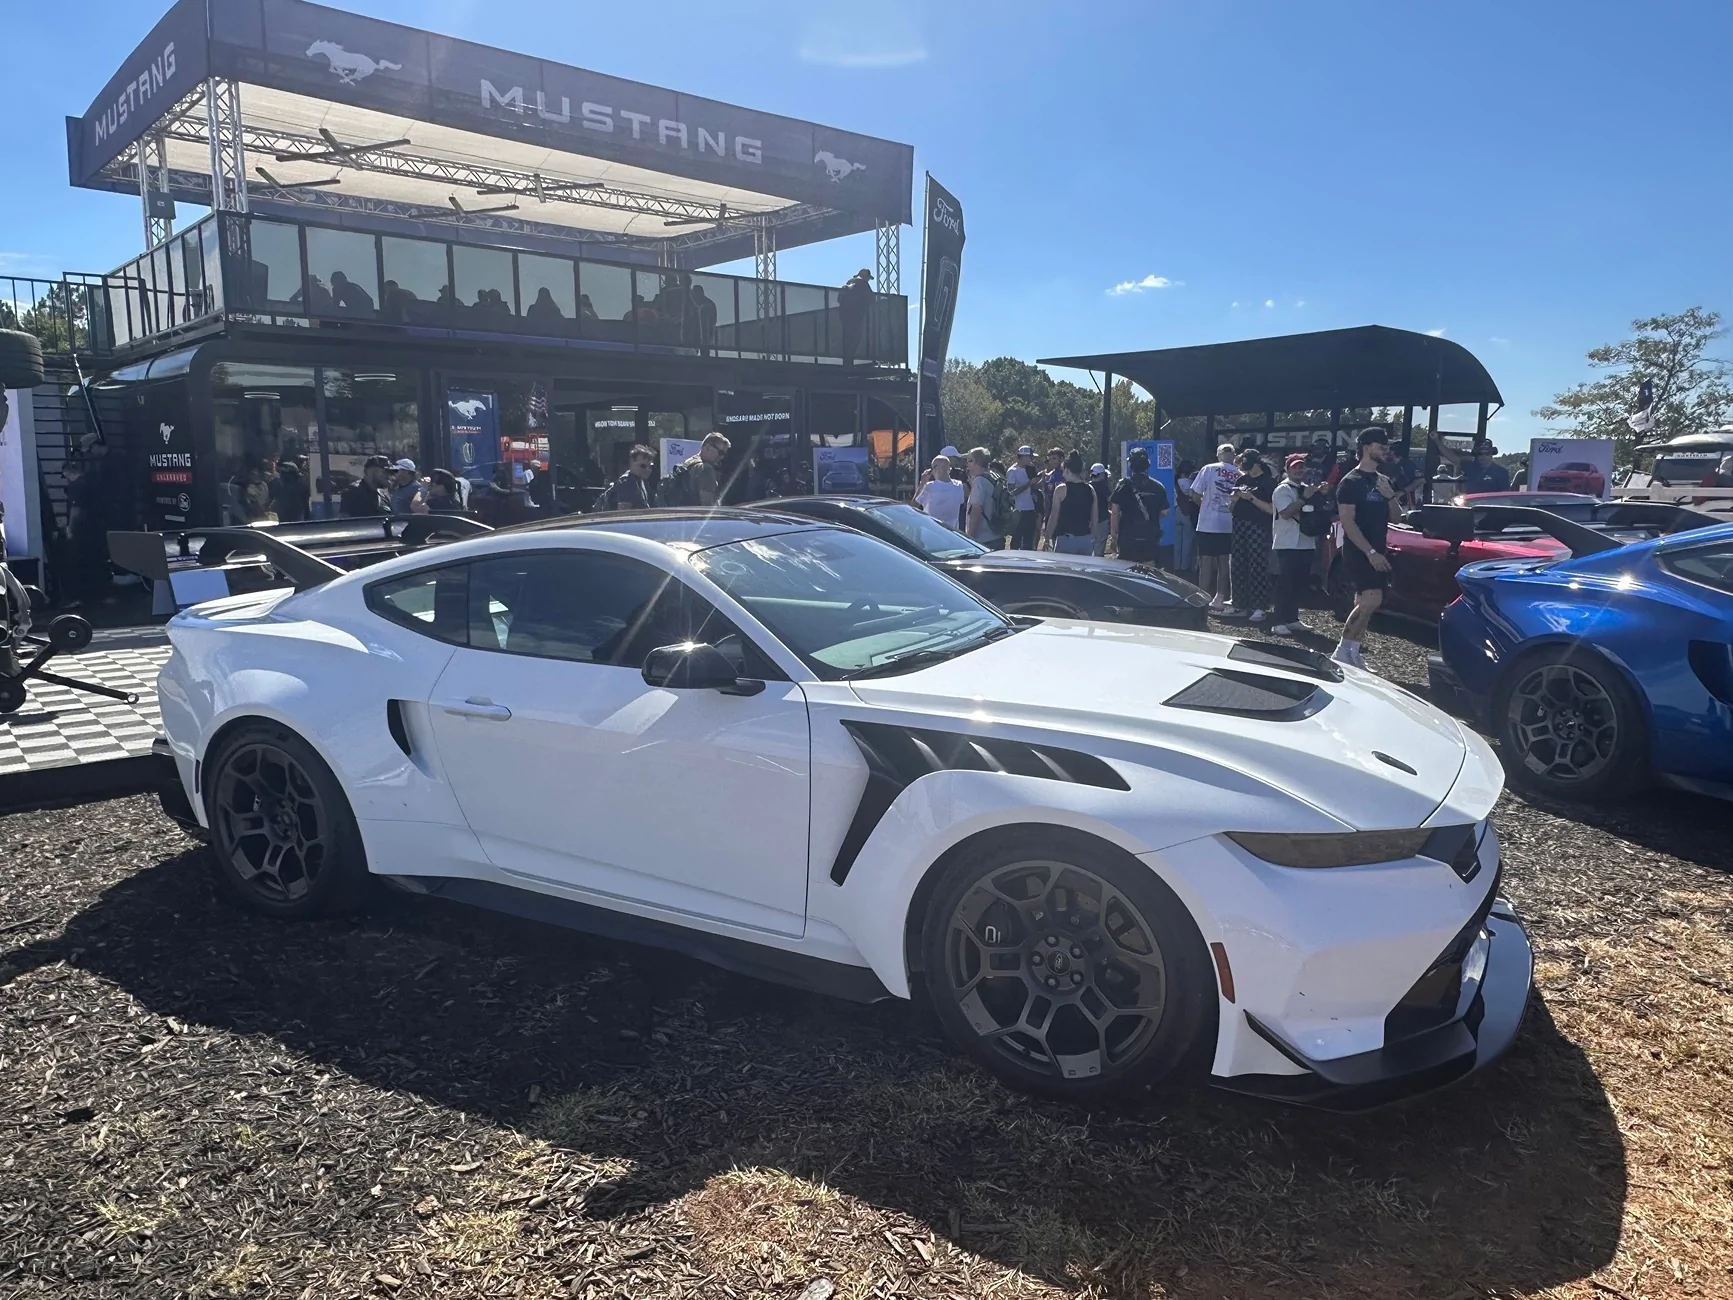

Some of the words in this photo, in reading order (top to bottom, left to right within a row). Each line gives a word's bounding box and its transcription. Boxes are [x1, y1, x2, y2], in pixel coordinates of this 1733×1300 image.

[95, 42, 176, 146] MUSTANG
[480, 78, 763, 165] MUSTANG
[933, 197, 959, 236] Ford
[749, 414, 763, 422] MADE
[763, 413, 774, 421] NOT
[774, 412, 790, 420] BORN
[1217, 430, 1358, 450] MSTAN
[1538, 441, 1564, 454] Ford
[669, 443, 685, 456] Ford
[149, 453, 192, 467] MUSTANG
